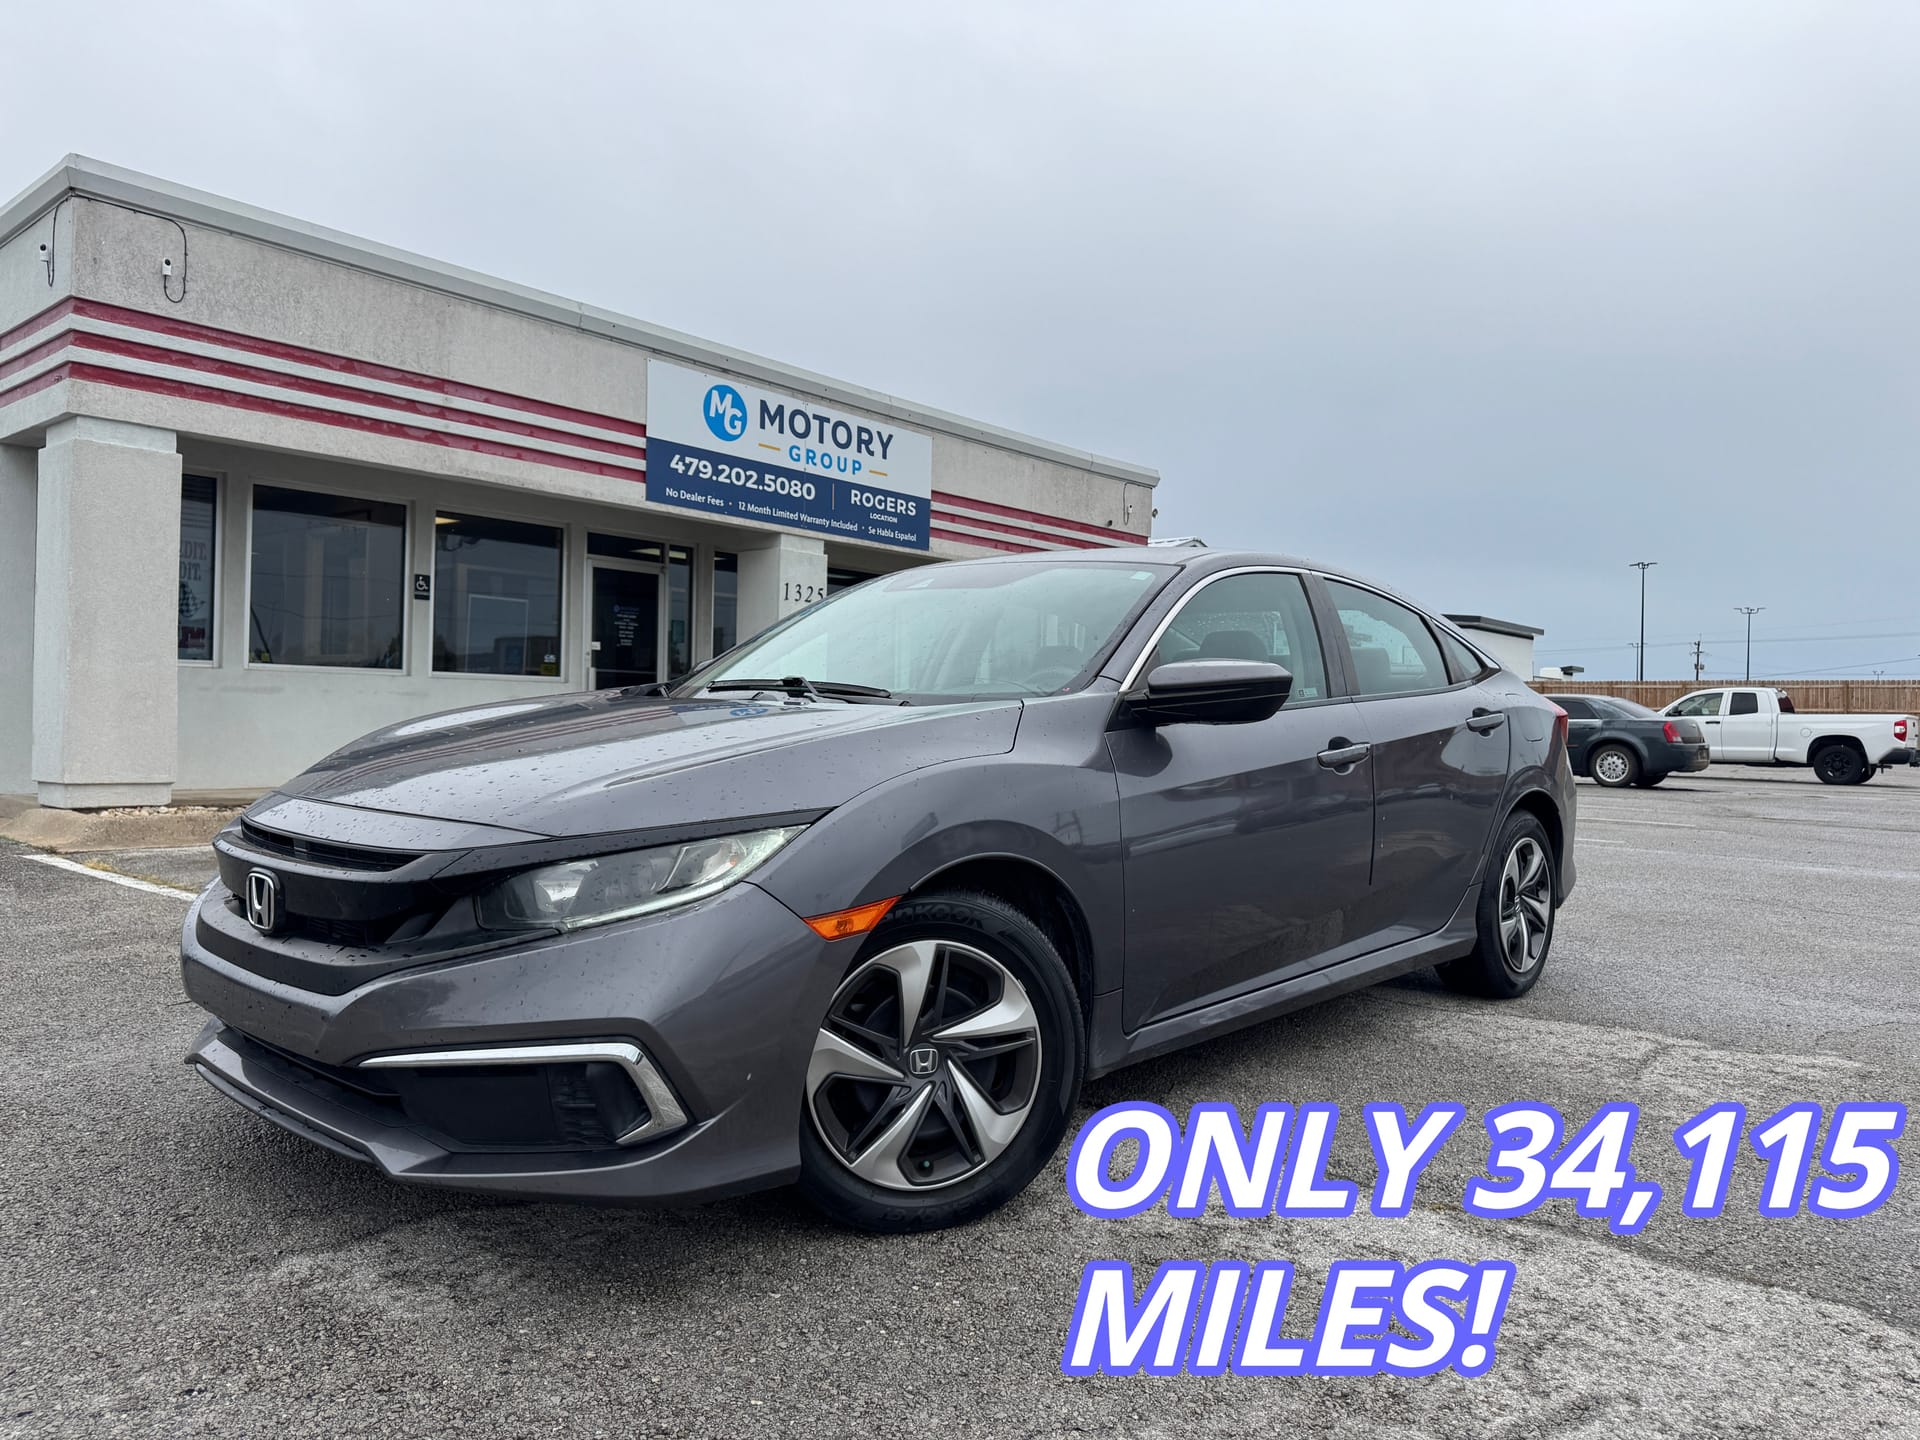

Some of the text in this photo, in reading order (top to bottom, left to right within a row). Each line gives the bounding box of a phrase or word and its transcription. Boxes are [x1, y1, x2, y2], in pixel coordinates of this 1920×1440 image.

[759, 399, 893, 460] MOTORY
[789, 445, 862, 475] GROUP
[670, 454, 816, 501] 479.202.5080
[666, 487, 917, 543] No Dealer Fees 12 Month Limited Warranty Included Se Habla Español
[851, 489, 917, 516] ROGERS
[870, 512, 898, 524] LOCATION
[784, 582, 824, 603] 1325
